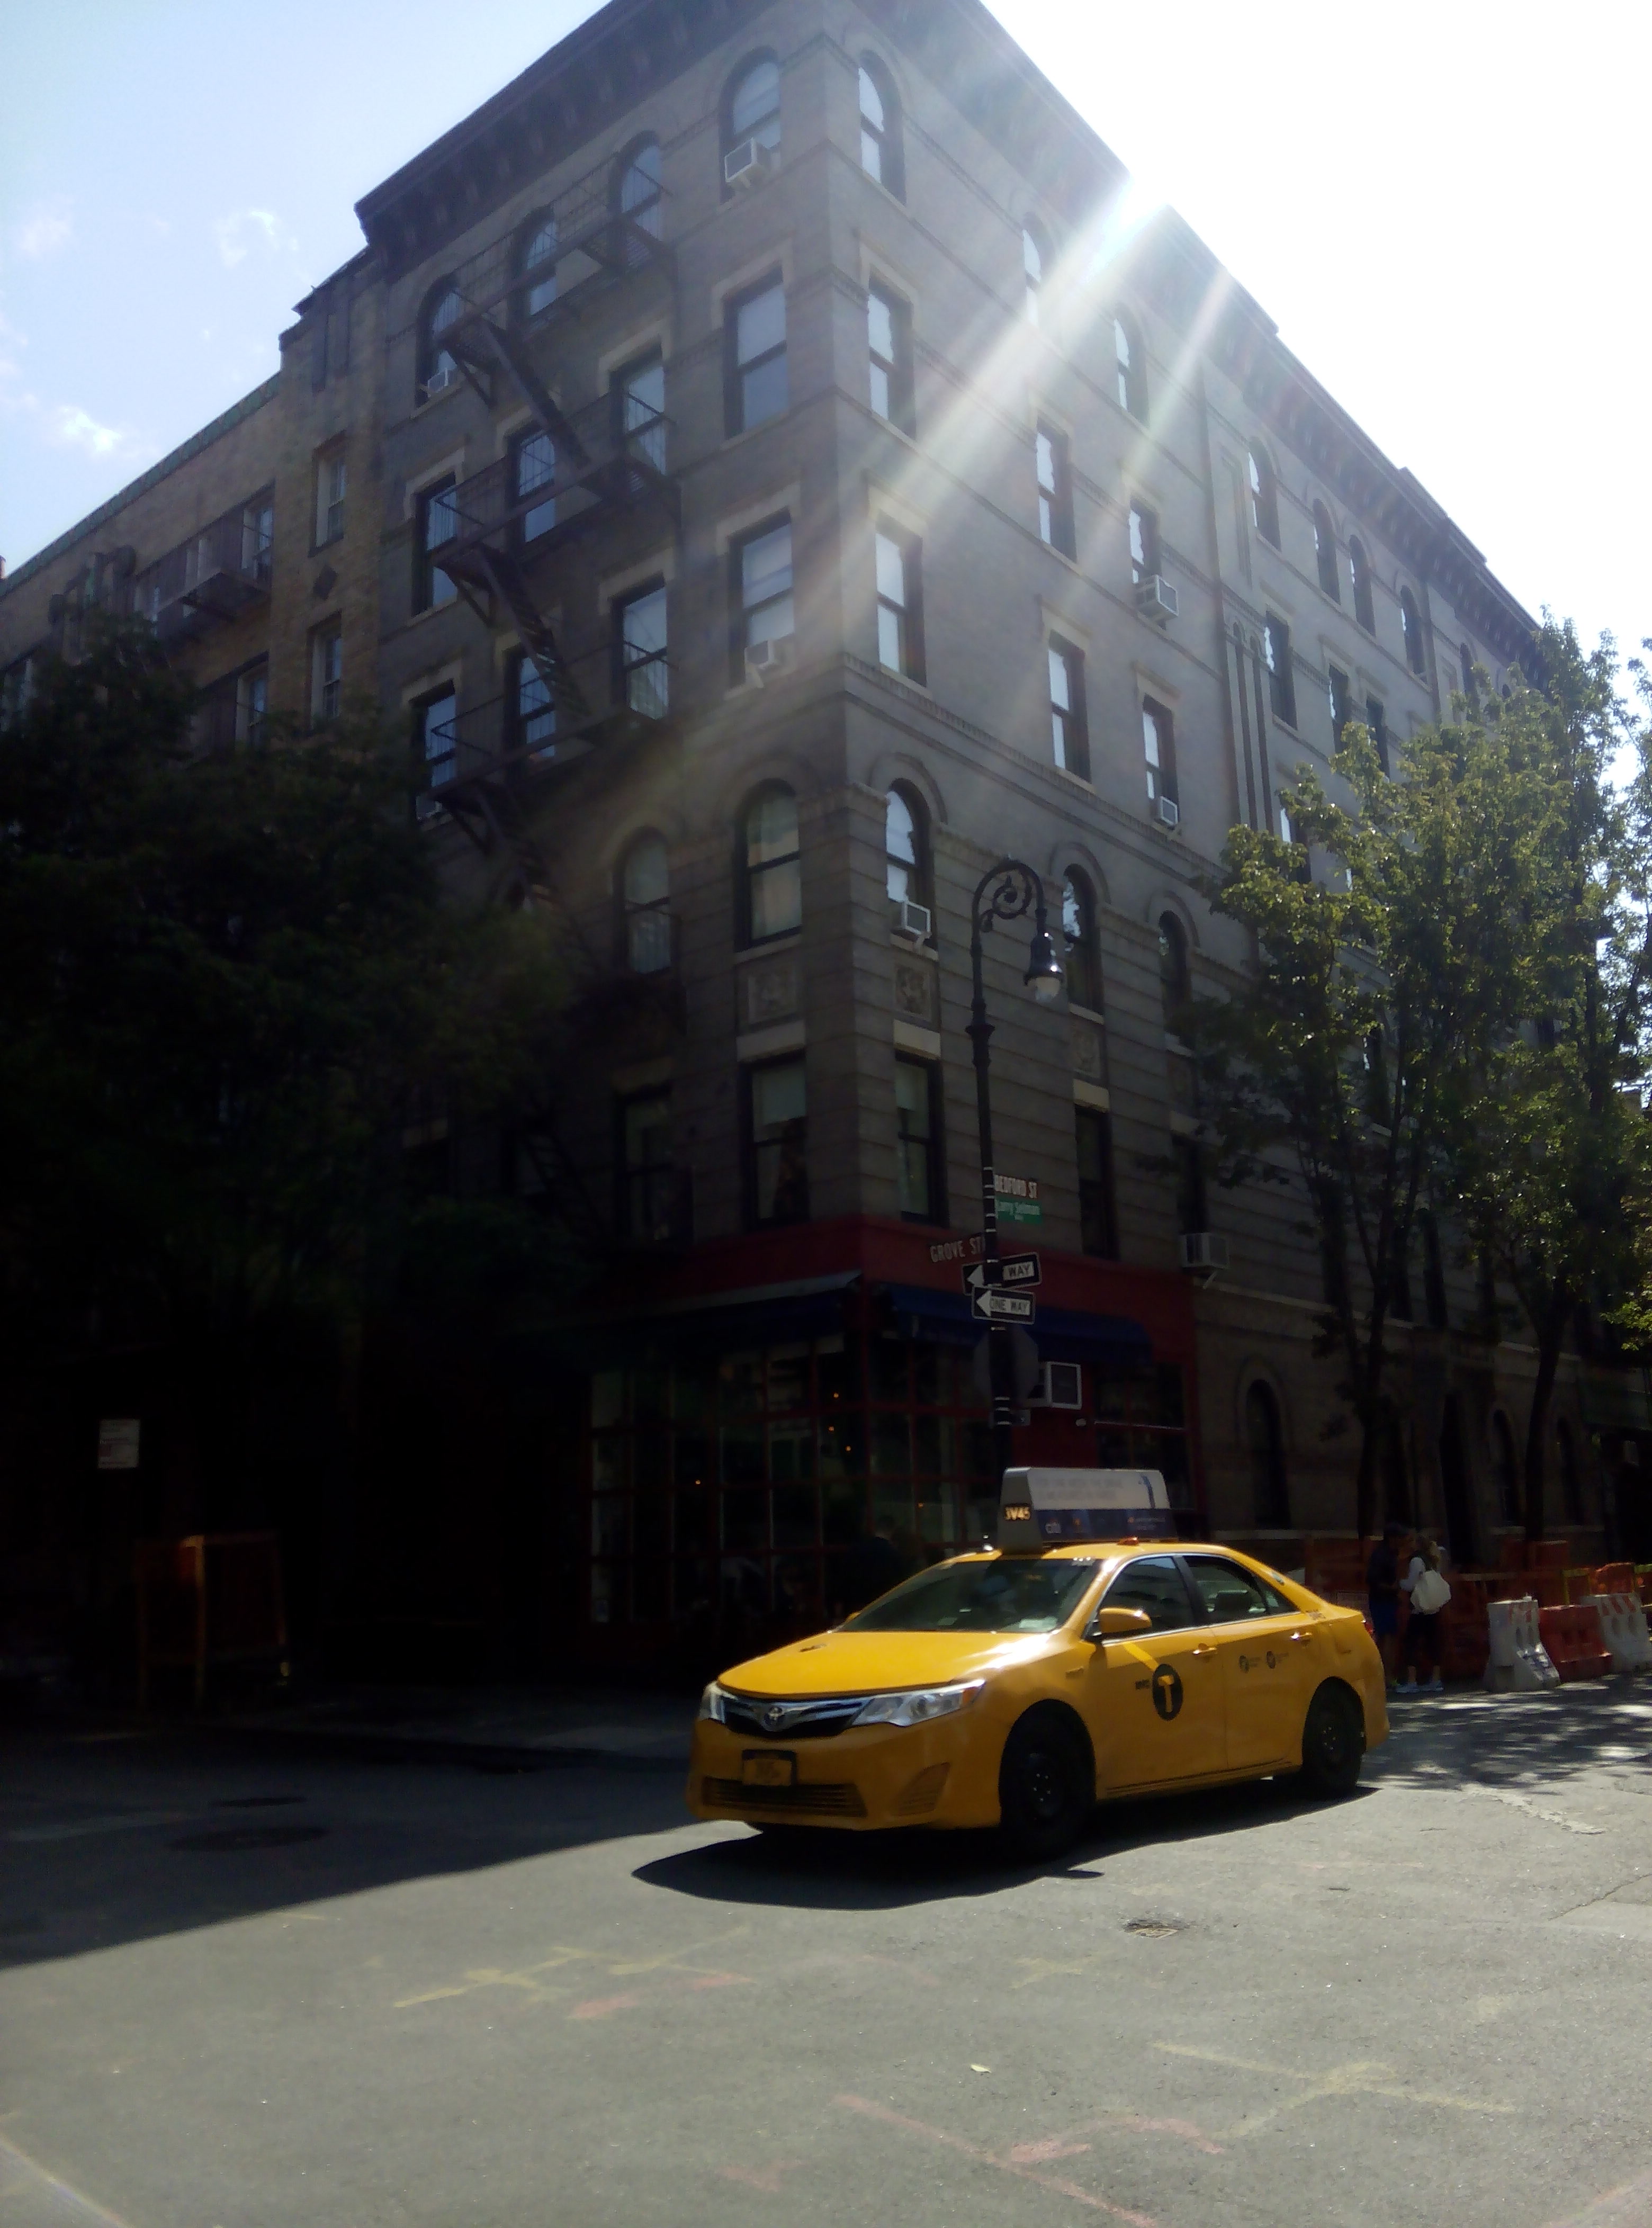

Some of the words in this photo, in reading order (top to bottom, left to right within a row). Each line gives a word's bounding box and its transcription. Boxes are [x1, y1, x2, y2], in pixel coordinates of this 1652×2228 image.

[930, 1241, 965, 1262] GROVE
[1009, 1264, 1030, 1277] WAY
[990, 1298, 1007, 1310] ONE
[1011, 1301, 1028, 1314] WAY
